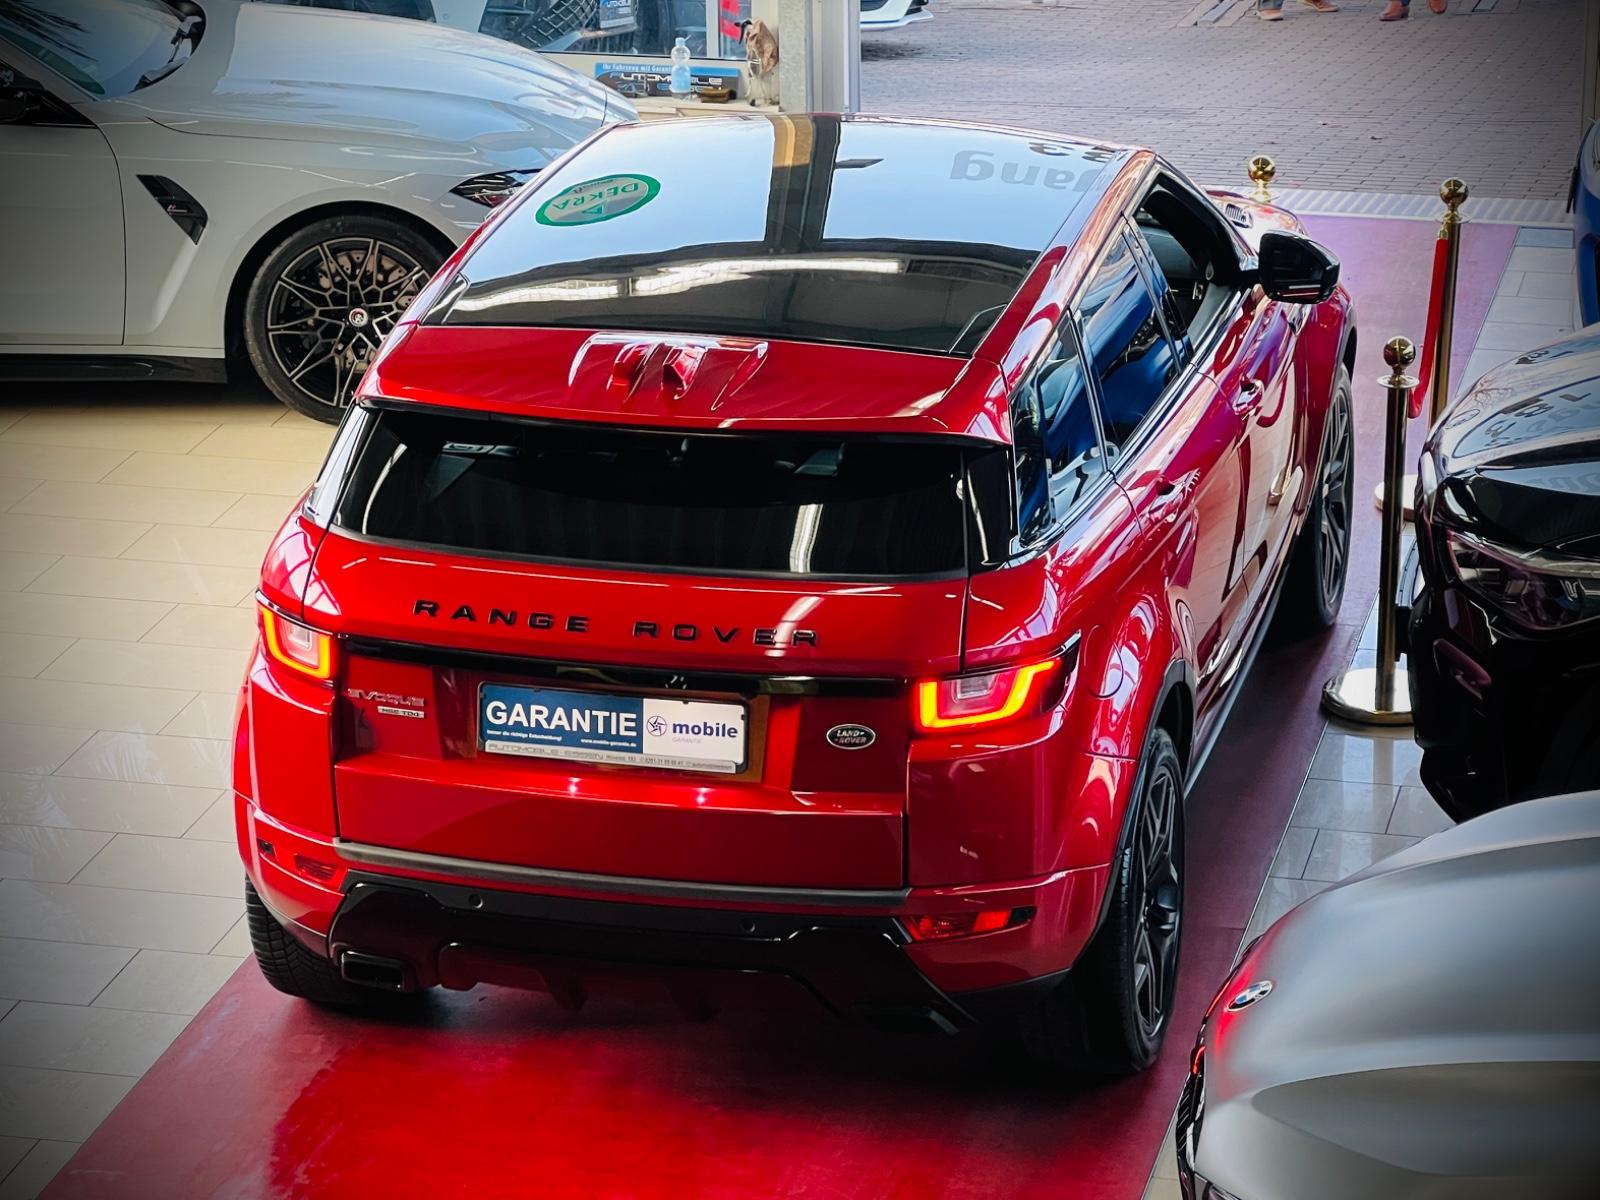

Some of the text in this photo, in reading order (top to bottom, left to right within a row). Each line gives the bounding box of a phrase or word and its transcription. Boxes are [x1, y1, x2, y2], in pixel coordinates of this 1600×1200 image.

[553, 182, 639, 210] DEKRA
[412, 599, 818, 647] RANGE ROVER
[347, 688, 425, 706] EVOQUE
[486, 700, 637, 736] GARANTIE
[672, 721, 738, 738] mobile
[836, 729, 860, 737] LAND
[838, 736, 867, 744] ROVER
